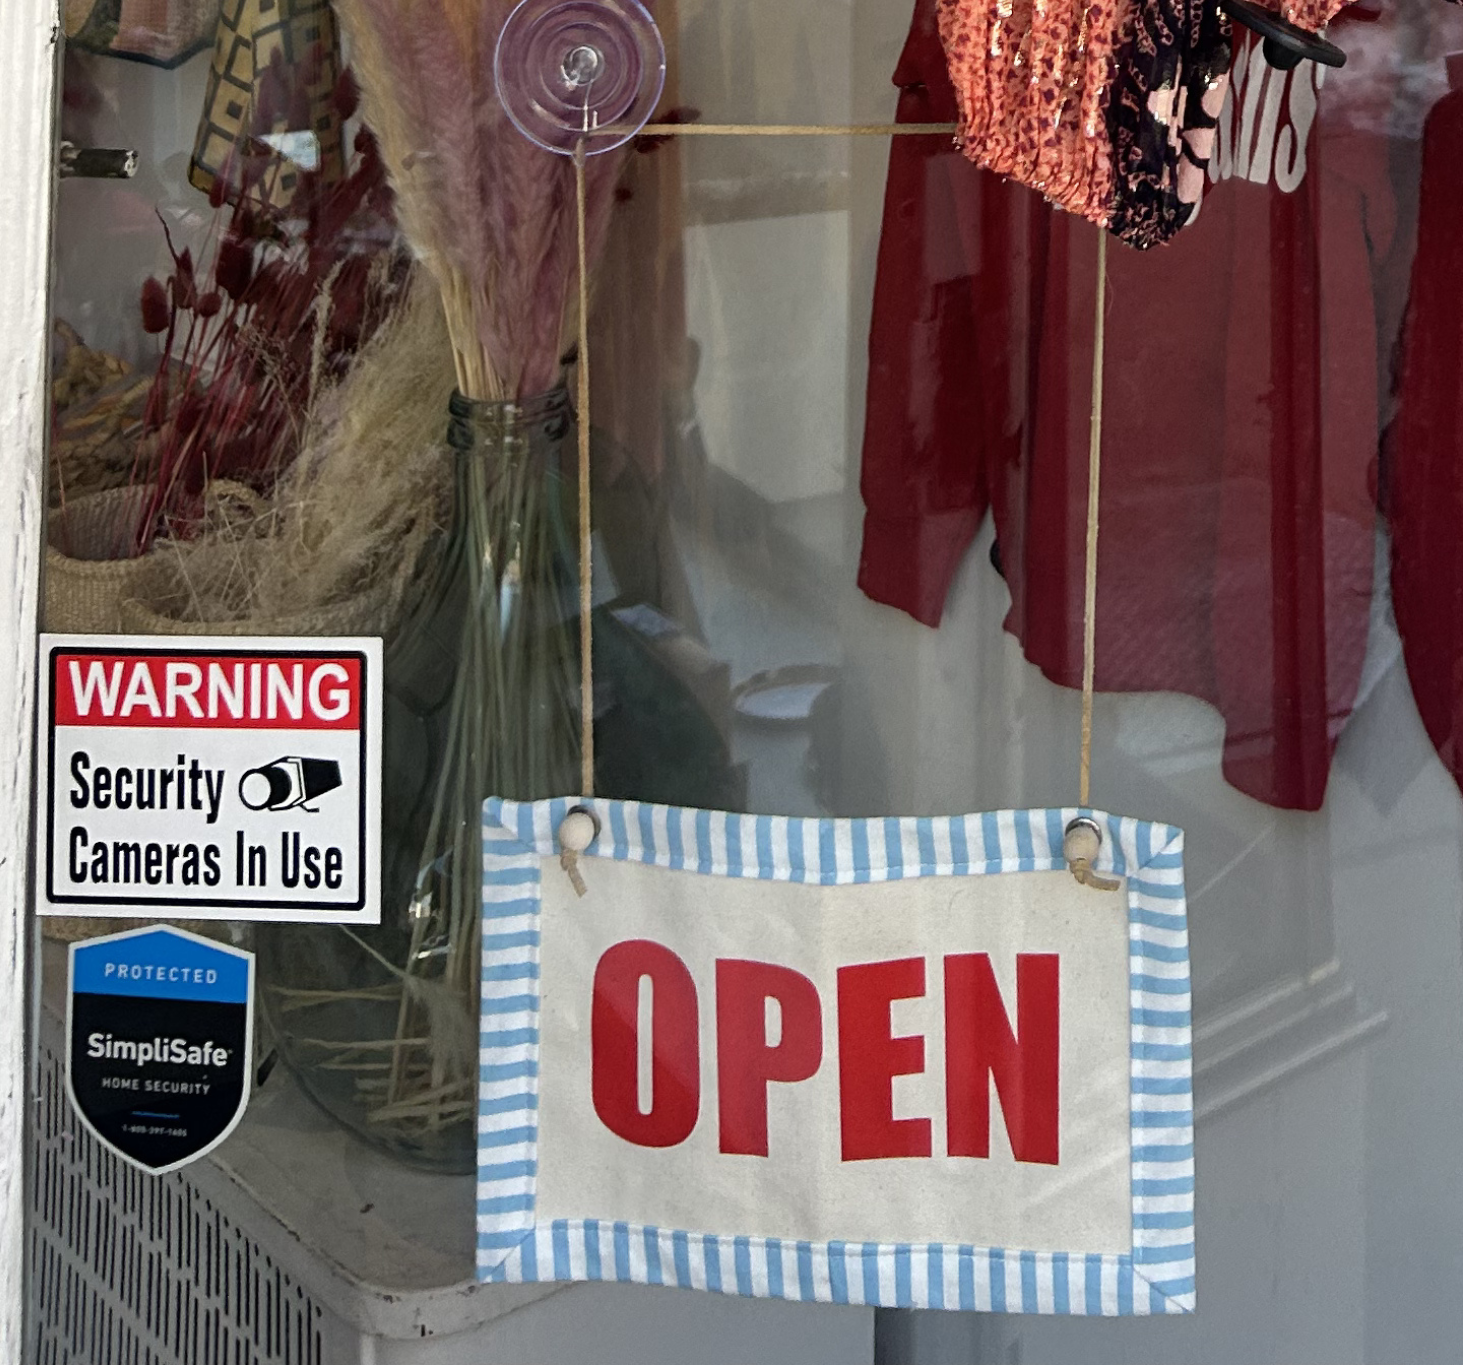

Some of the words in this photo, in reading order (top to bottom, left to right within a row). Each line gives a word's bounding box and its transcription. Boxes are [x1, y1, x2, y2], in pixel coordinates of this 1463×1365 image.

[68, 660, 352, 722] WARNING
[69, 751, 224, 824] Security
[68, 826, 222, 888] Cameras
[236, 833, 268, 889] In
[281, 832, 344, 891] Use
[104, 962, 217, 984] PROTECTED
[86, 1032, 229, 1067] SimpliSafe
[591, 939, 1060, 1166] OPEN
[102, 1077, 139, 1090] HOME
[144, 1080, 211, 1095] SECURITY
